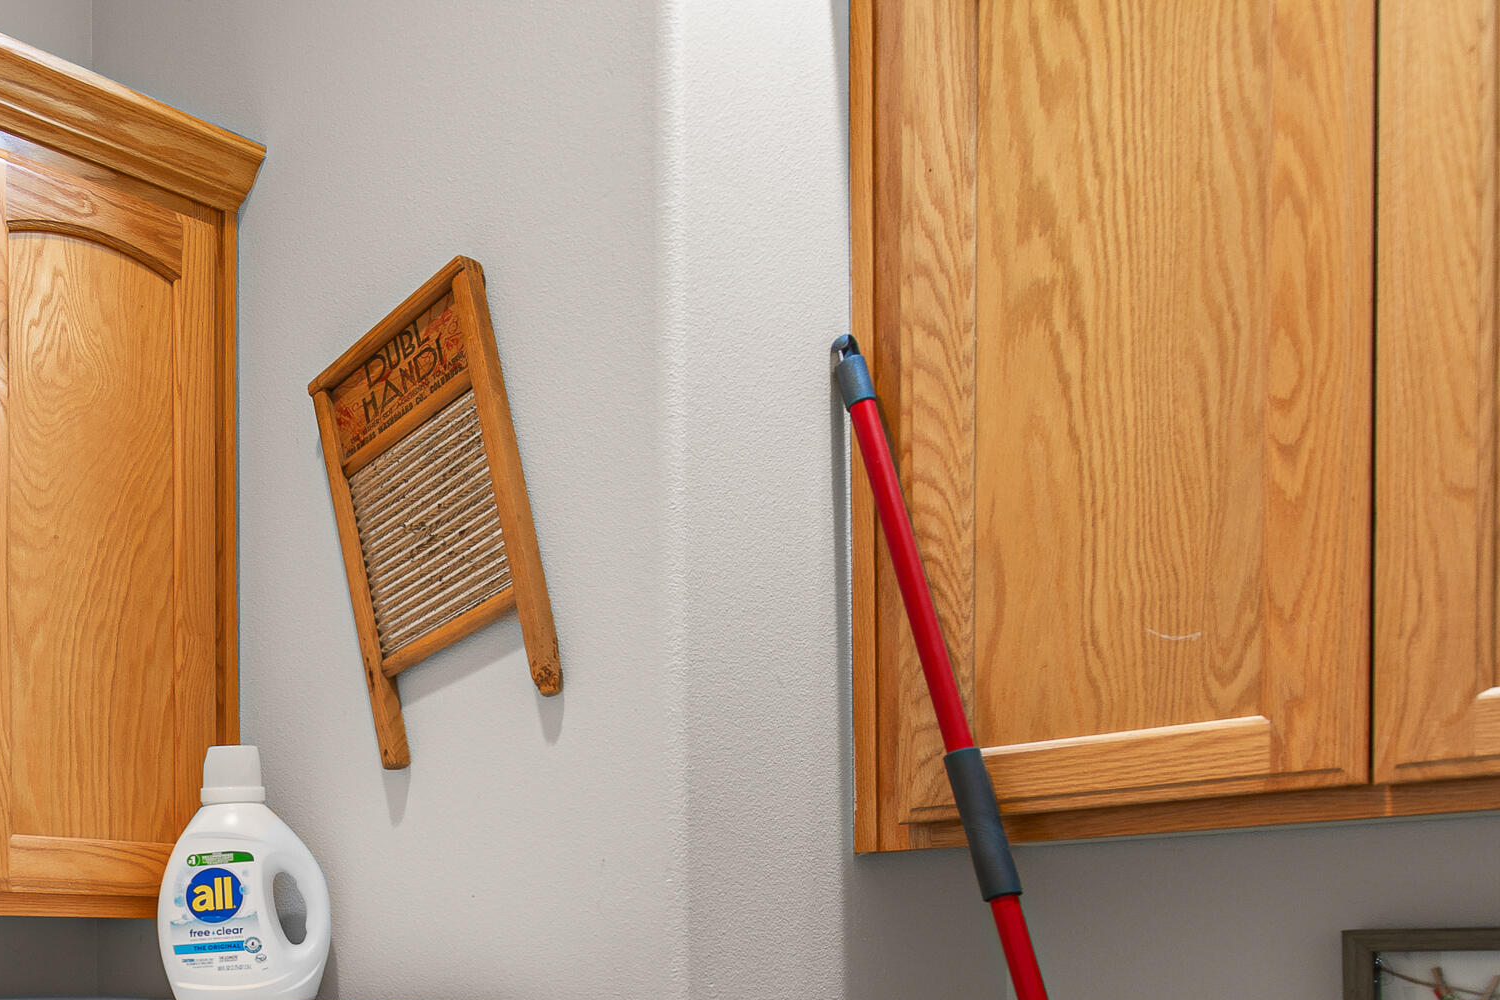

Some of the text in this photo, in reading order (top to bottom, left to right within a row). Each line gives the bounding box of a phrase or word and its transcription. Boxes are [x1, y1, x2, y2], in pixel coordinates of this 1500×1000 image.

[364, 319, 430, 390] DUBL
[361, 338, 446, 425] HANDI
[191, 876, 234, 912] all
[189, 926, 244, 938] free clear
[208, 943, 240, 951] ORIGINAL
